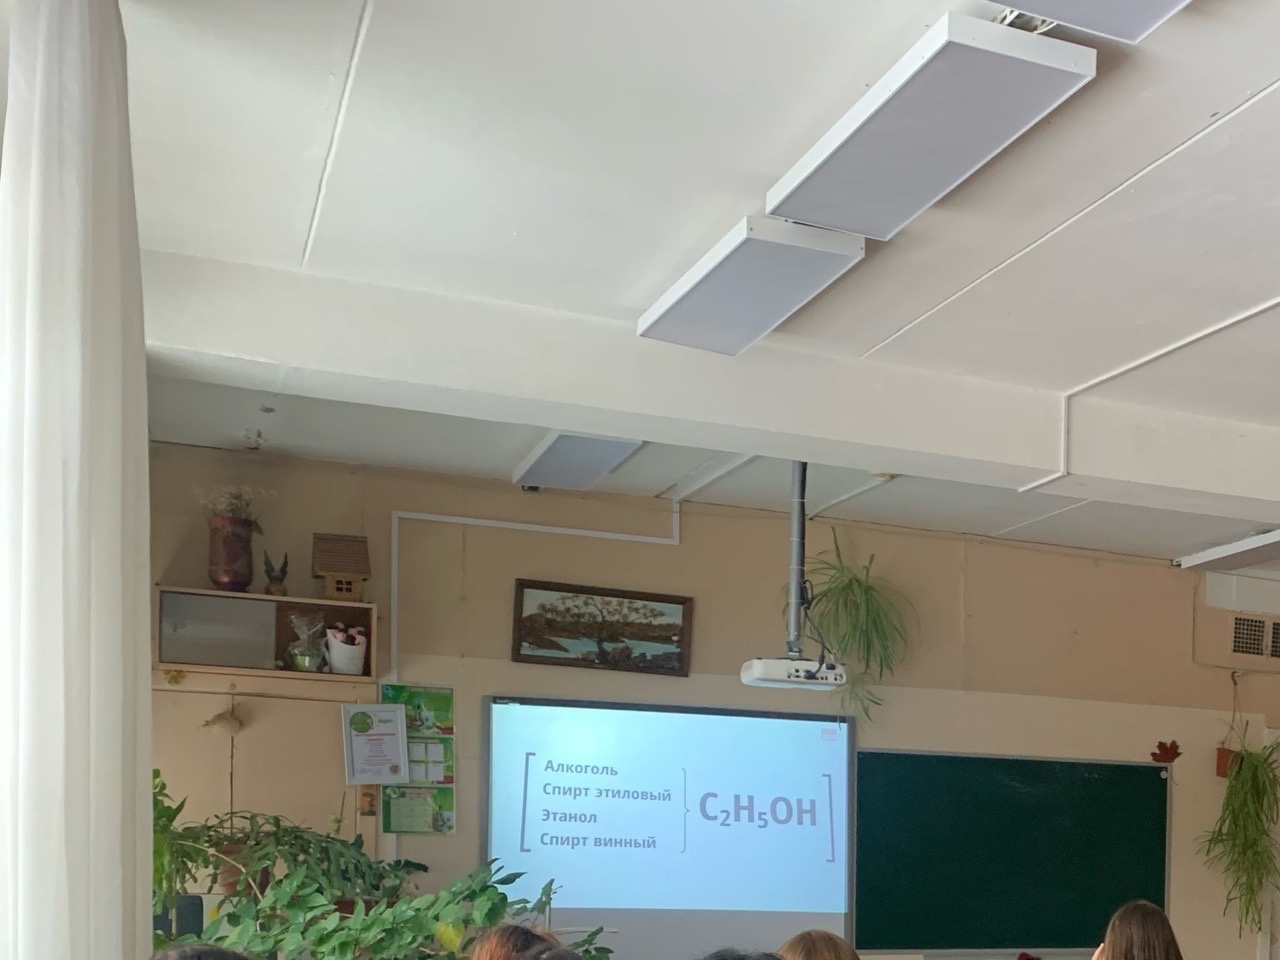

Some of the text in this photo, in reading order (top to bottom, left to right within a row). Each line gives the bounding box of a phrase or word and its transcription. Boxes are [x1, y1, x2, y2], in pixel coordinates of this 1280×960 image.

[544, 760, 618, 776] Алкоголь
[542, 782, 672, 802] Спирт этиловый
[541, 809, 597, 824] Этанол
[540, 832, 657, 850] Спирт винный
